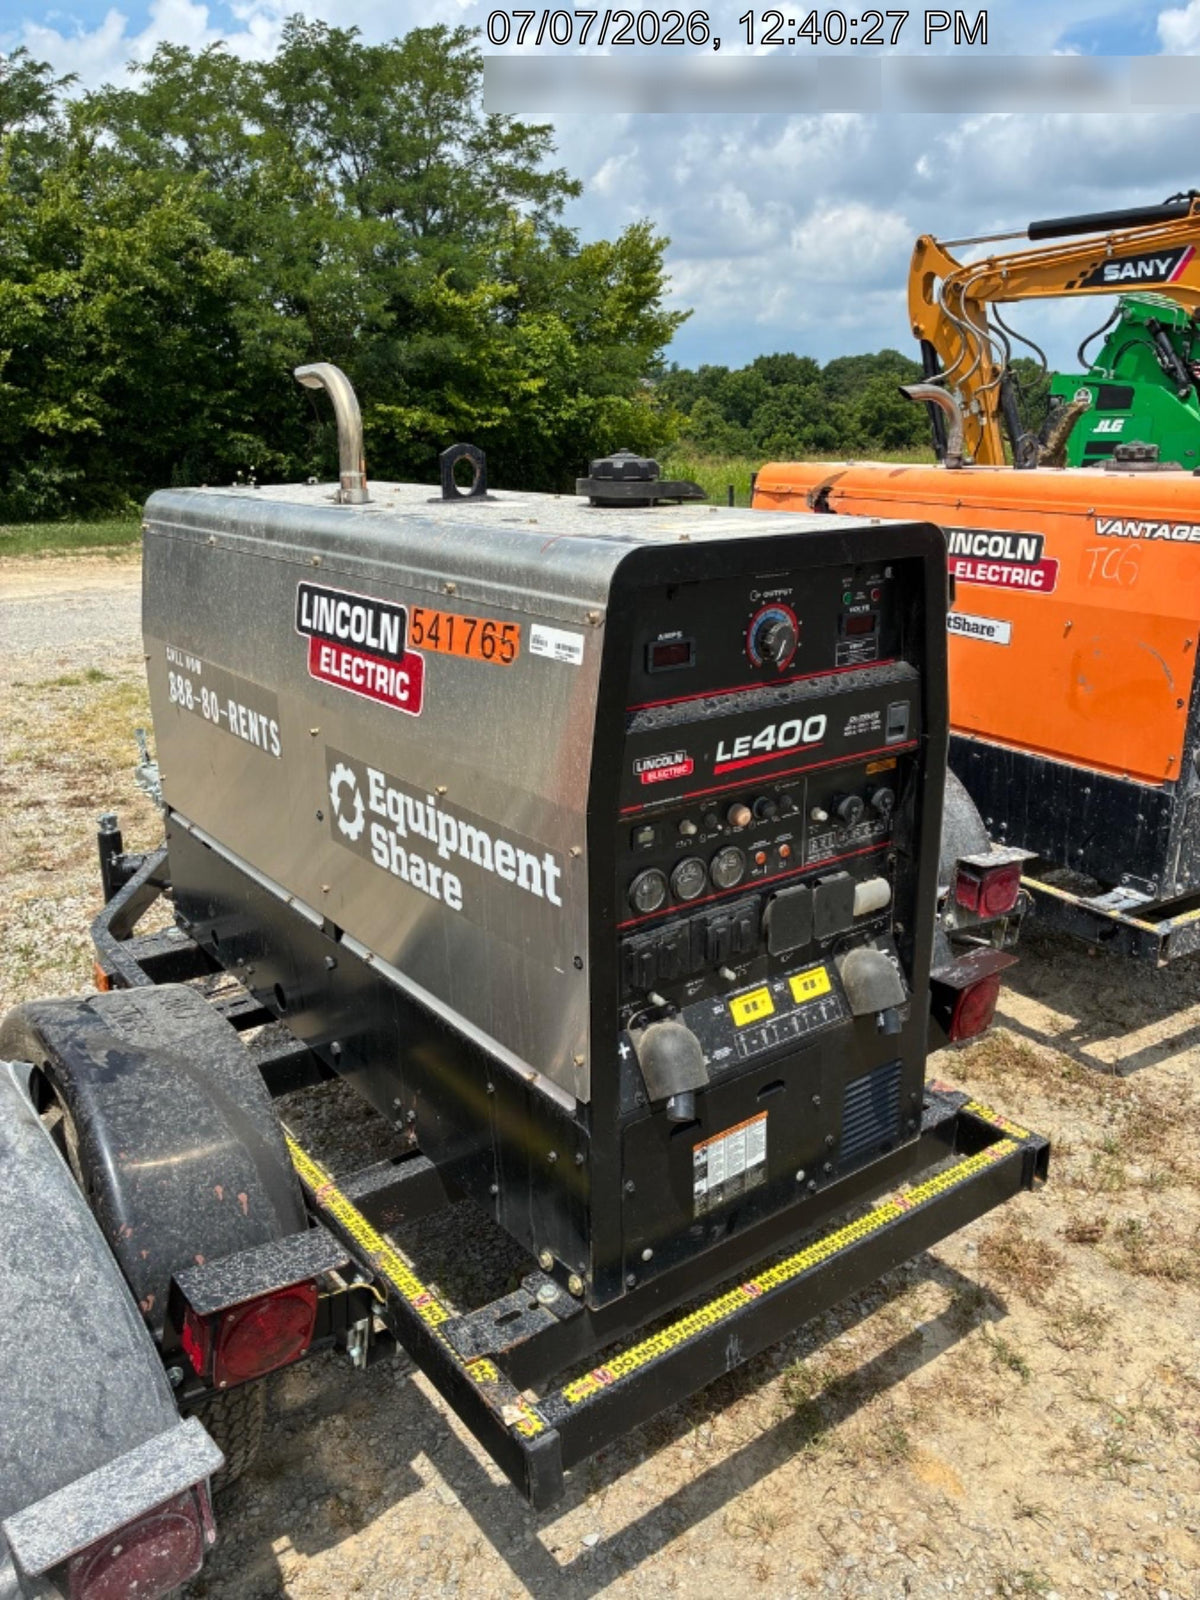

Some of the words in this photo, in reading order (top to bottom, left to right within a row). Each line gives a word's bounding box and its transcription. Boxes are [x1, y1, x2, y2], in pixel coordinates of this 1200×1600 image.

[1103, 257, 1173, 282] SANY
[1092, 418, 1125, 433] JLG
[948, 531, 1038, 561] INCOLN
[954, 561, 1045, 587] ELECTRIC
[762, 588, 794, 598] OUTPUT
[301, 591, 400, 655] LINCOLN
[411, 607, 516, 664] 541765
[947, 615, 996, 637] tShare
[320, 645, 410, 701] ELECTRIC
[168, 670, 281, 758] 888-80-RENTS
[715, 714, 828, 762] LE400
[635, 752, 684, 772] LINCOLN
[647, 763, 689, 782] ELECTRIC
[366, 767, 563, 908] Equipment
[370, 821, 464, 912] Share
[423, 1304, 441, 1323] NO
[610, 1354, 635, 1374] DO
[634, 1337, 666, 1361] NOT
[665, 1310, 711, 1343] STAND
[709, 1290, 747, 1317] HERE
[776, 1259, 801, 1277] PAS
